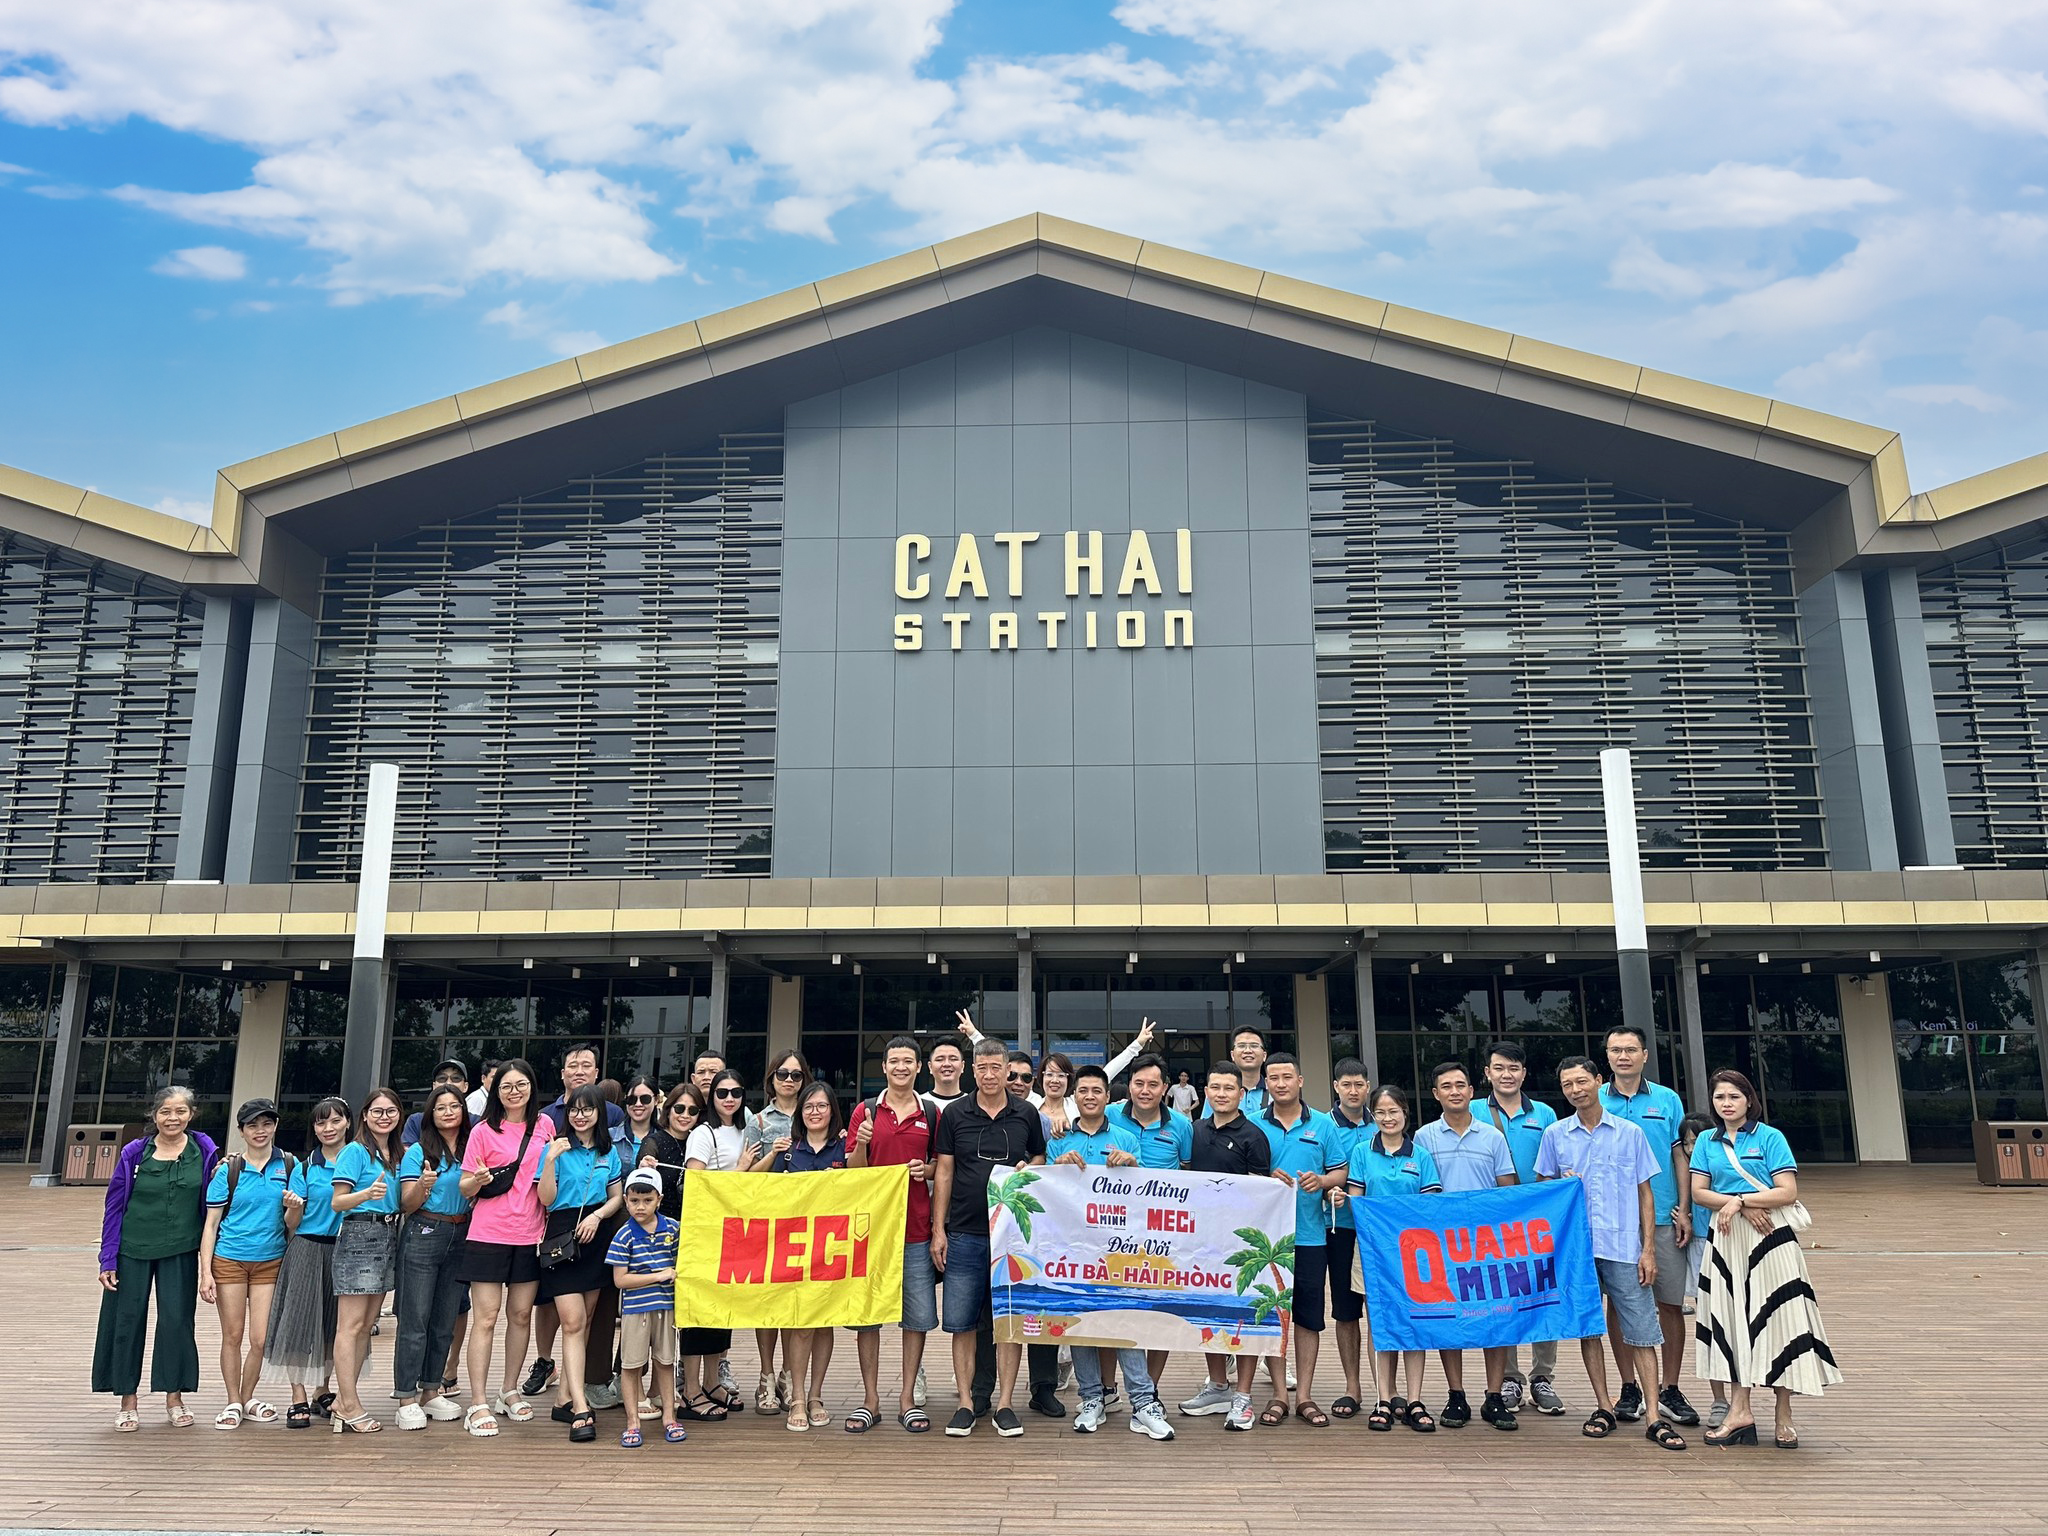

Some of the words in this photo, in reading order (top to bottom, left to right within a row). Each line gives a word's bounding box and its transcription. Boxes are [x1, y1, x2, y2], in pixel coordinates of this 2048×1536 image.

[894, 531, 1041, 600] CAT
[1064, 528, 1193, 597] HAI
[893, 609, 1194, 651] STATION
[1919, 1020, 1947, 1031] Kem
[1928, 1034, 2008, 1056] ITLI
[1092, 1176, 1132, 1196] Chào
[1135, 1179, 1190, 1203] Mừng
[1086, 1203, 1127, 1225] QUANG
[1100, 1214, 1126, 1226] MINH
[1108, 1236, 1139, 1254] Đến
[1144, 1239, 1171, 1257] Với
[1045, 1255, 1079, 1278] CÁT
[1083, 1258, 1109, 1280] BÀ
[1124, 1262, 1158, 1285] HẢI
[1163, 1265, 1232, 1289] PHÒNG
[1399, 1218, 1555, 1304] QUANG
[1456, 1256, 1558, 1303] MINH
